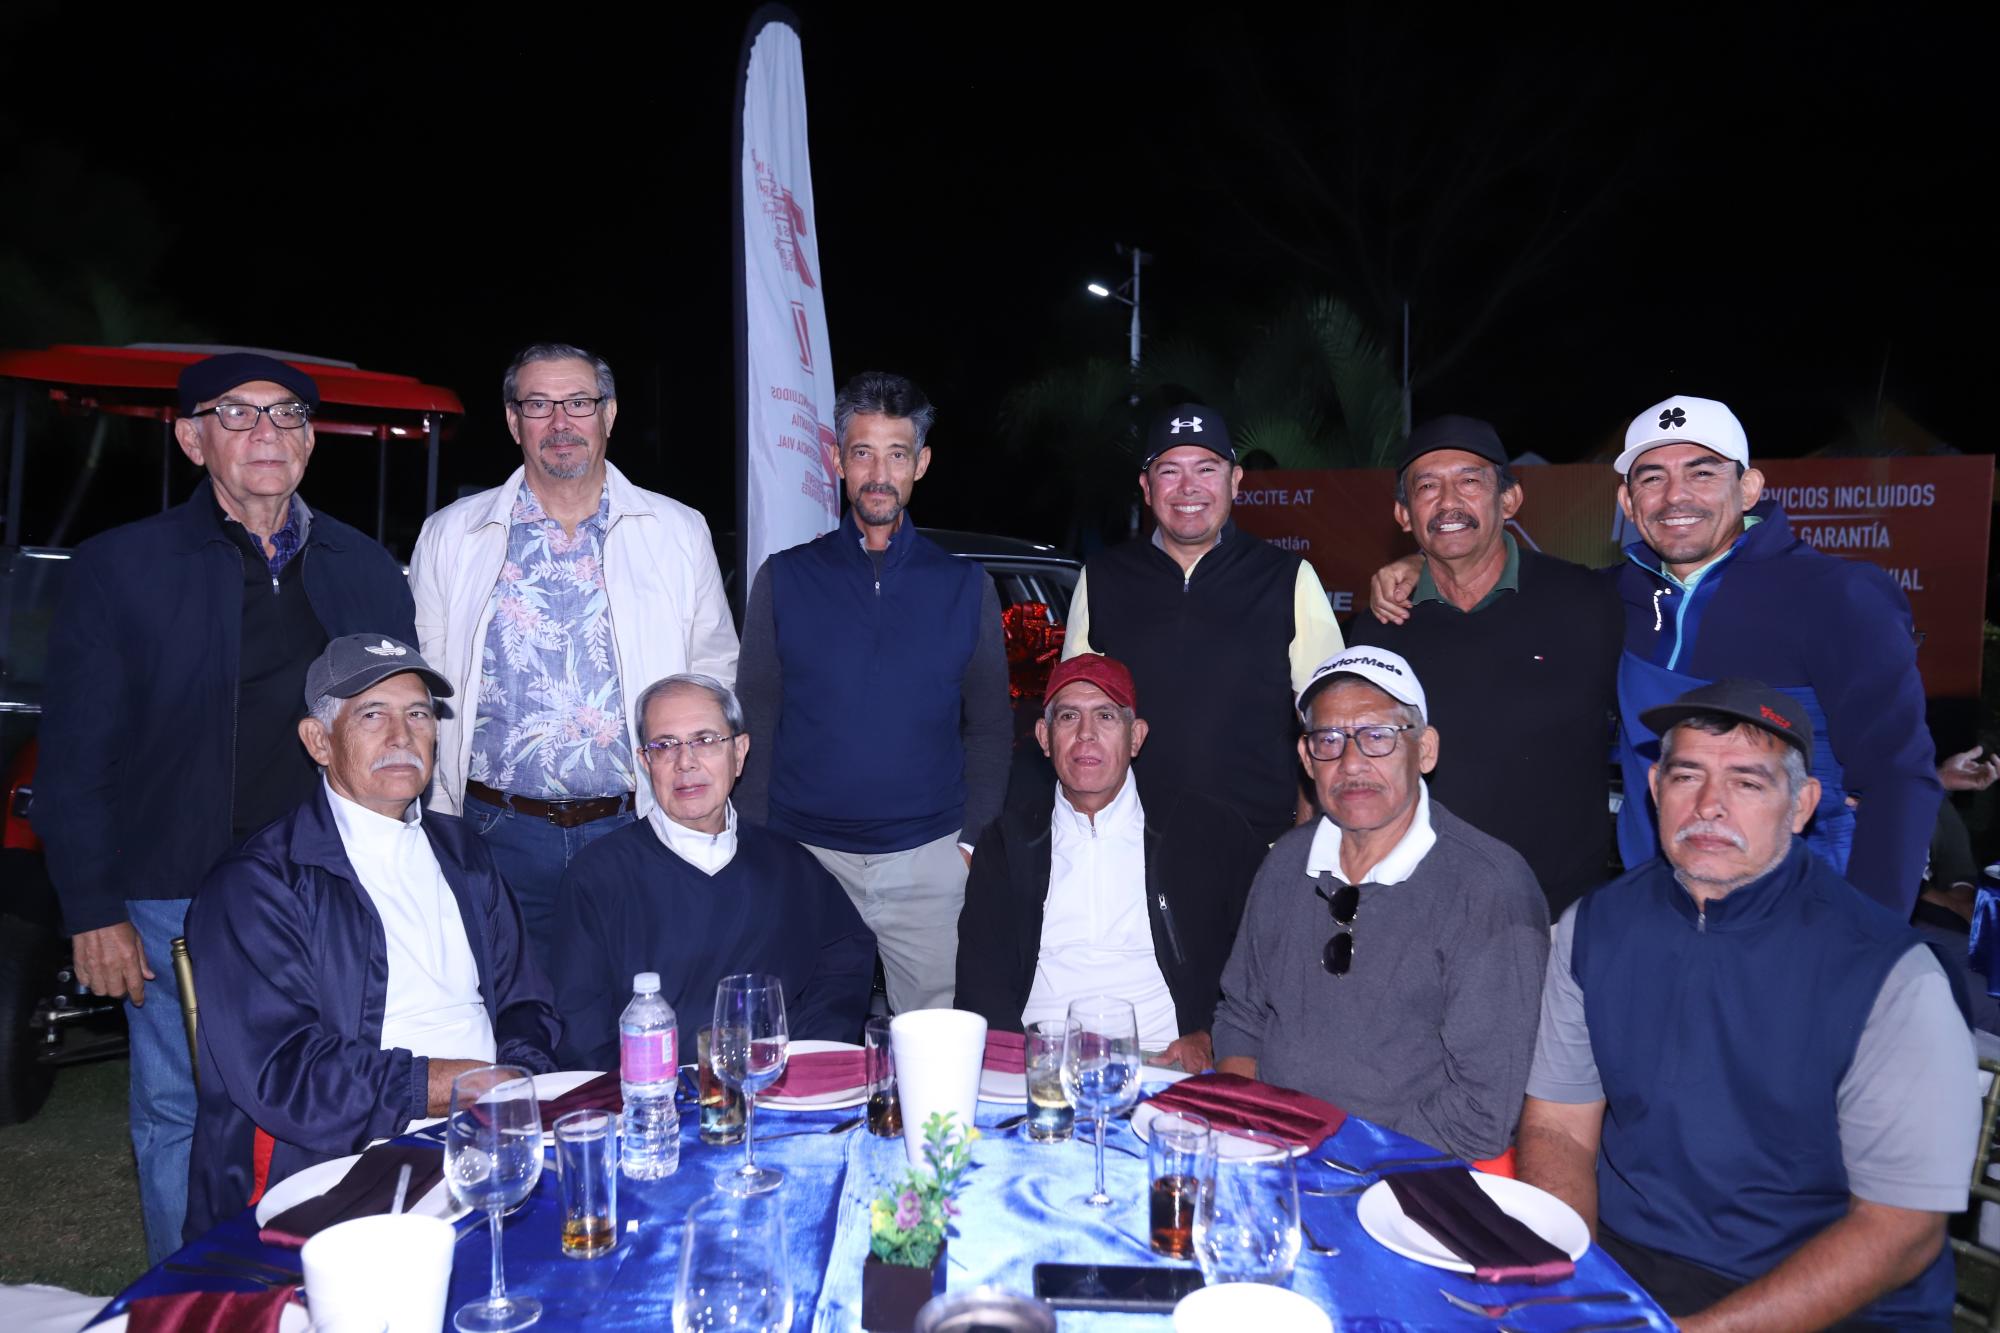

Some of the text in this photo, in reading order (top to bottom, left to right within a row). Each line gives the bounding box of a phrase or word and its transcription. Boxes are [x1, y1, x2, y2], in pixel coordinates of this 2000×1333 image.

[1234, 489, 1314, 506] EXCITE AT
[1759, 484, 1936, 509] RVICIOS INCLUIDOS
[1800, 522, 1890, 548] GARANTÍA
